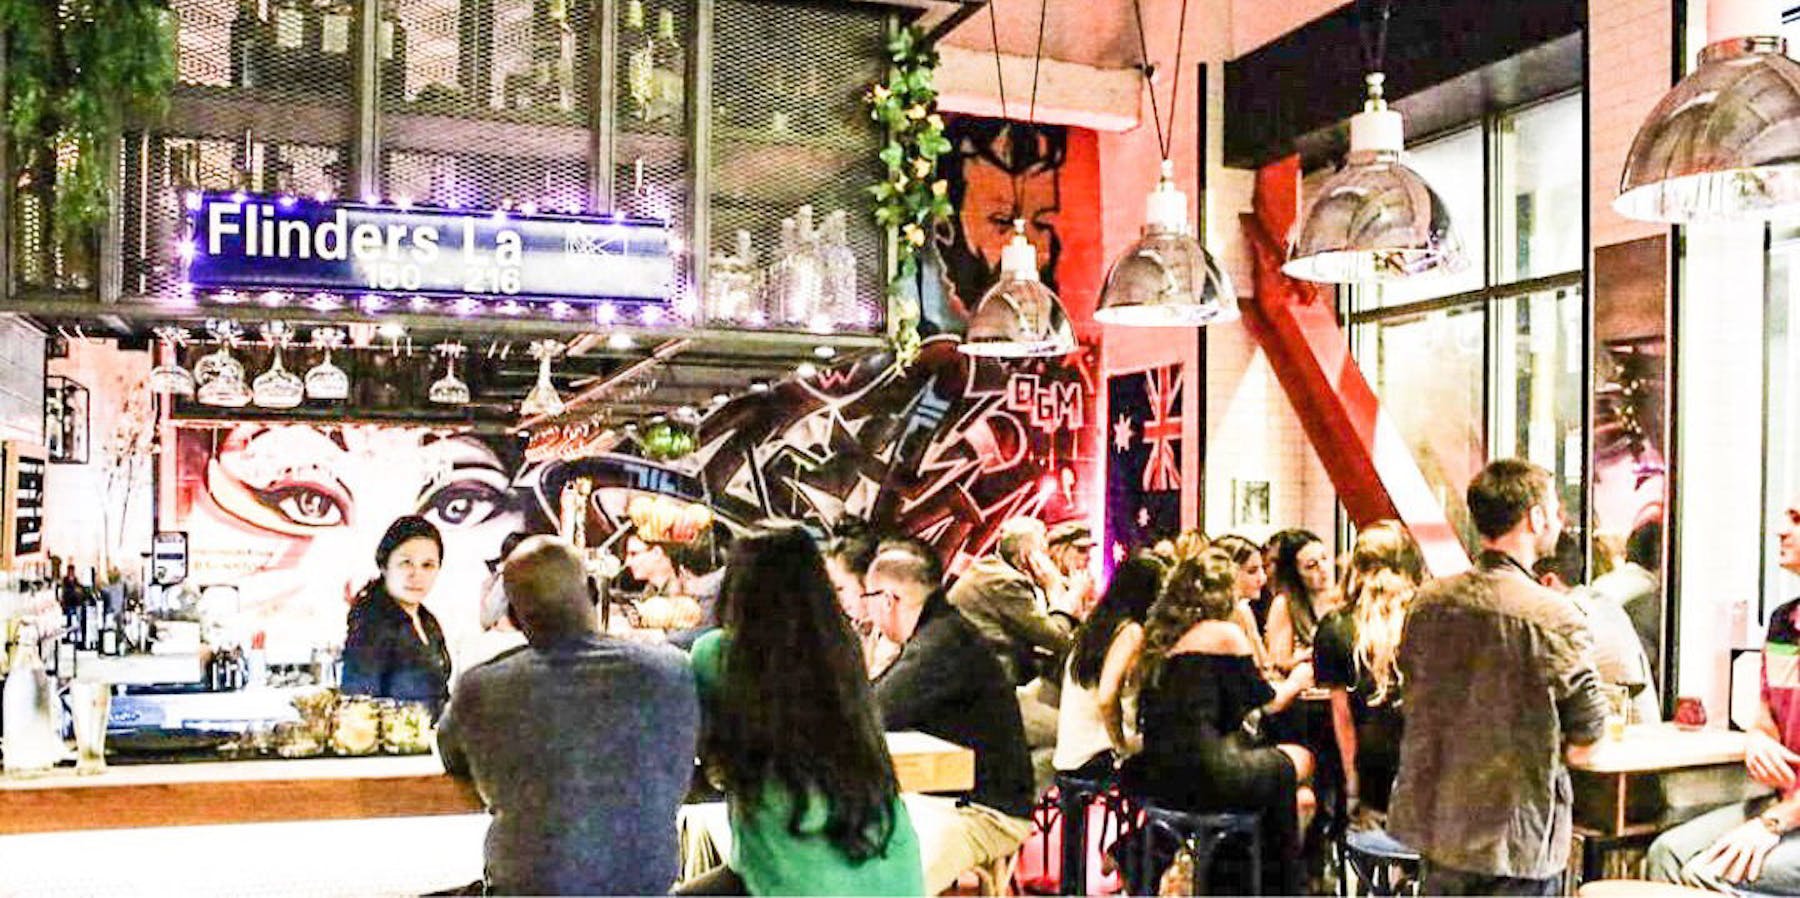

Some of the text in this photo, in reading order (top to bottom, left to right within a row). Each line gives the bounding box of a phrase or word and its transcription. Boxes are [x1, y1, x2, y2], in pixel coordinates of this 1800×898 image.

[208, 201, 522, 267] Flinders La
[463, 267, 521, 295] 216
